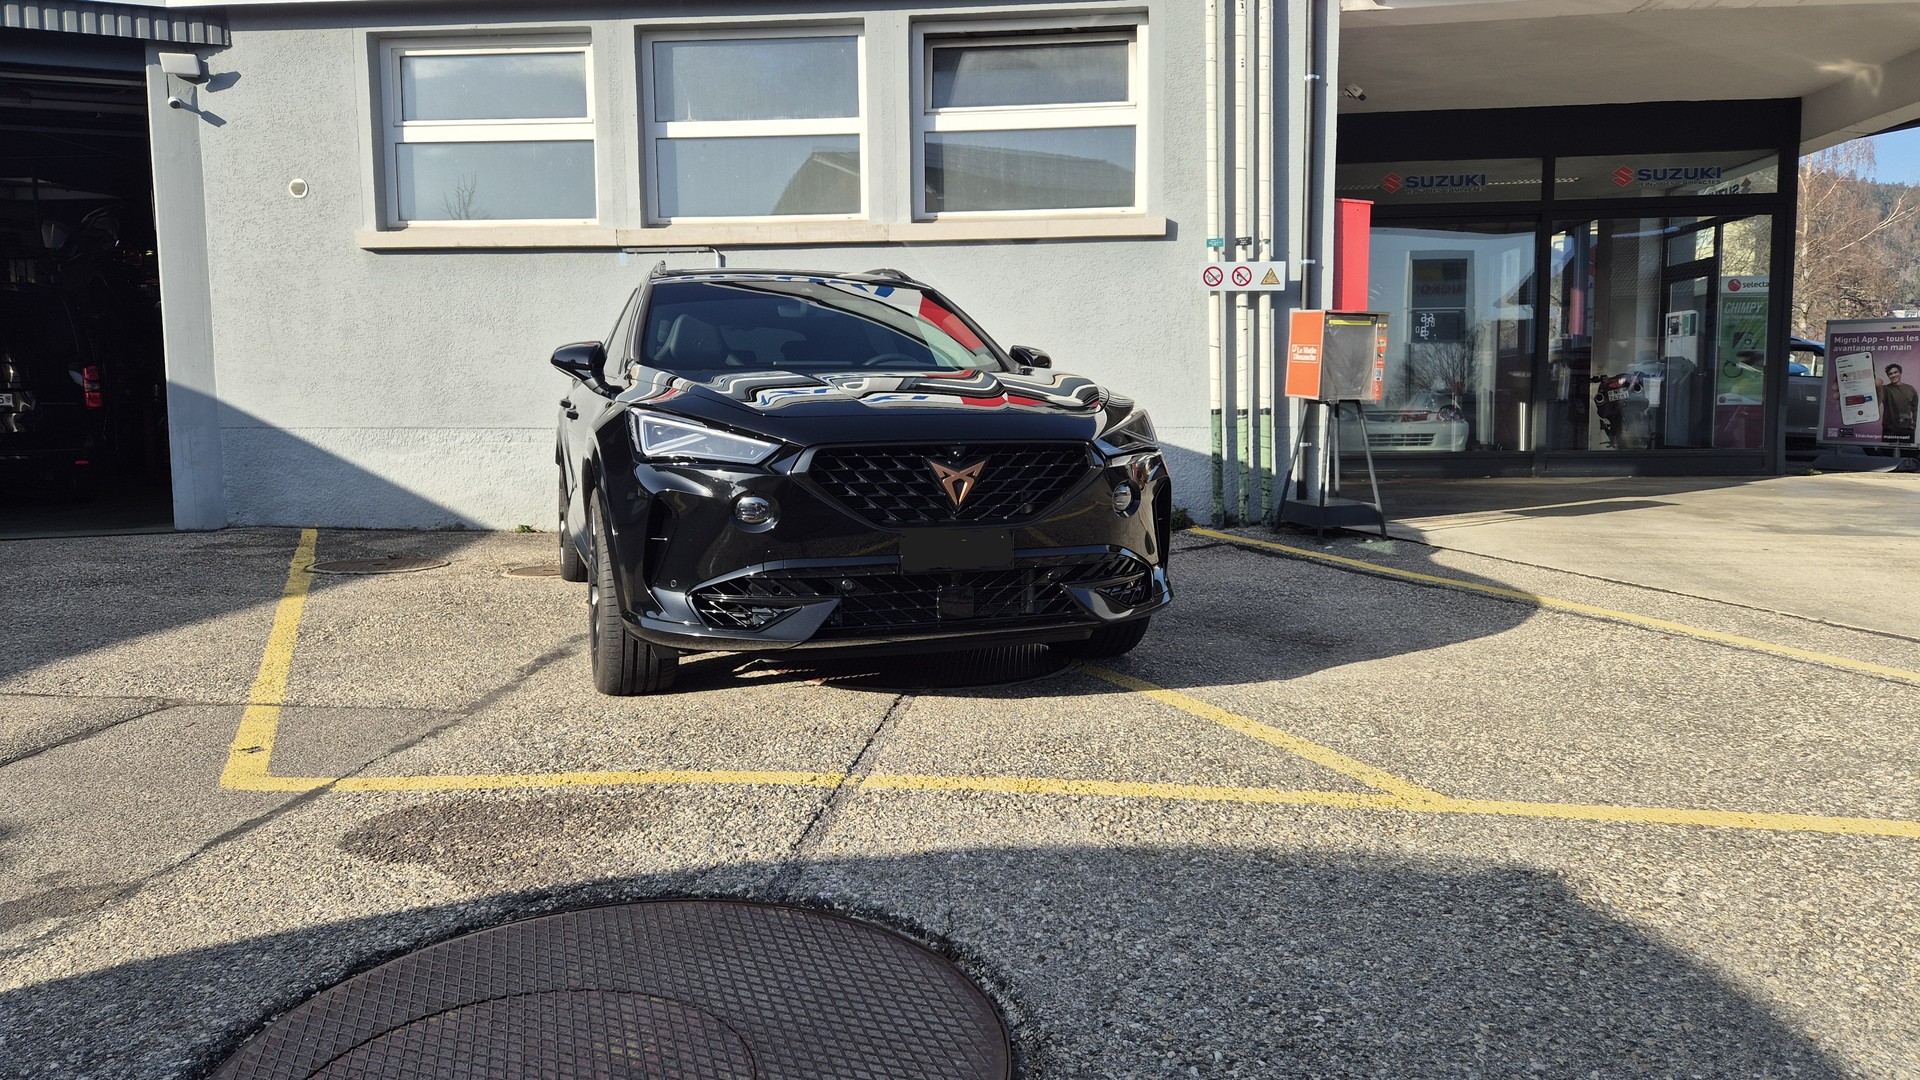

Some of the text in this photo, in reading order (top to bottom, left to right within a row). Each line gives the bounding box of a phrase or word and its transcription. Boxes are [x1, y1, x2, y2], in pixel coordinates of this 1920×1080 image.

[1637, 166, 1722, 181] SUZUKI
[1405, 173, 1486, 188] SUZUKI
[1724, 302, 1763, 314] CHIMPY
[1833, 336, 1860, 345] Migrol
[1861, 336, 1878, 344] App
[1906, 334, 1920, 342] les
[1890, 343, 1912, 351] main
